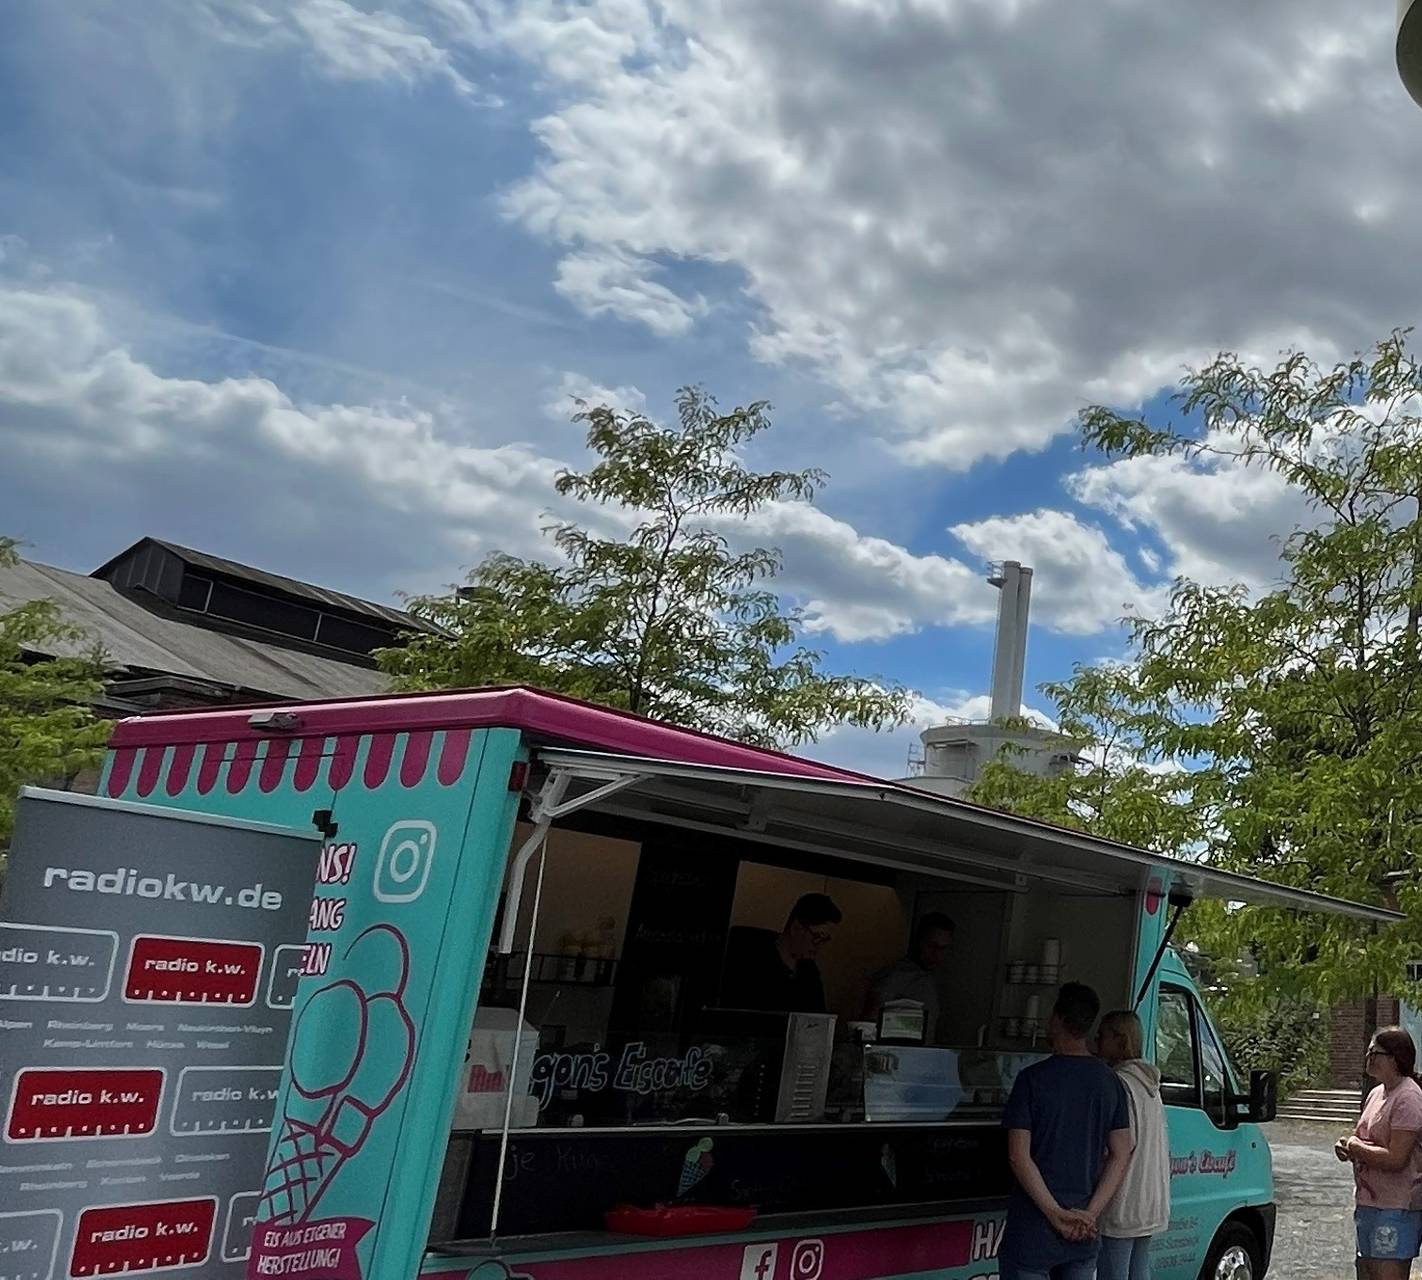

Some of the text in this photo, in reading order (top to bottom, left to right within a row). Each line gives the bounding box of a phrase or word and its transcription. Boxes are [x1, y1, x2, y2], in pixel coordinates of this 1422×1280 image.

[43, 866, 283, 911] radiokw.de
[144, 957, 246, 976] radio k.w.
[31, 1089, 145, 1106] radio k.w.
[191, 1087, 243, 1102] radio
[91, 1221, 199, 1243] radio k.w.
[257, 1248, 342, 1275] HERSTELLUNG!
